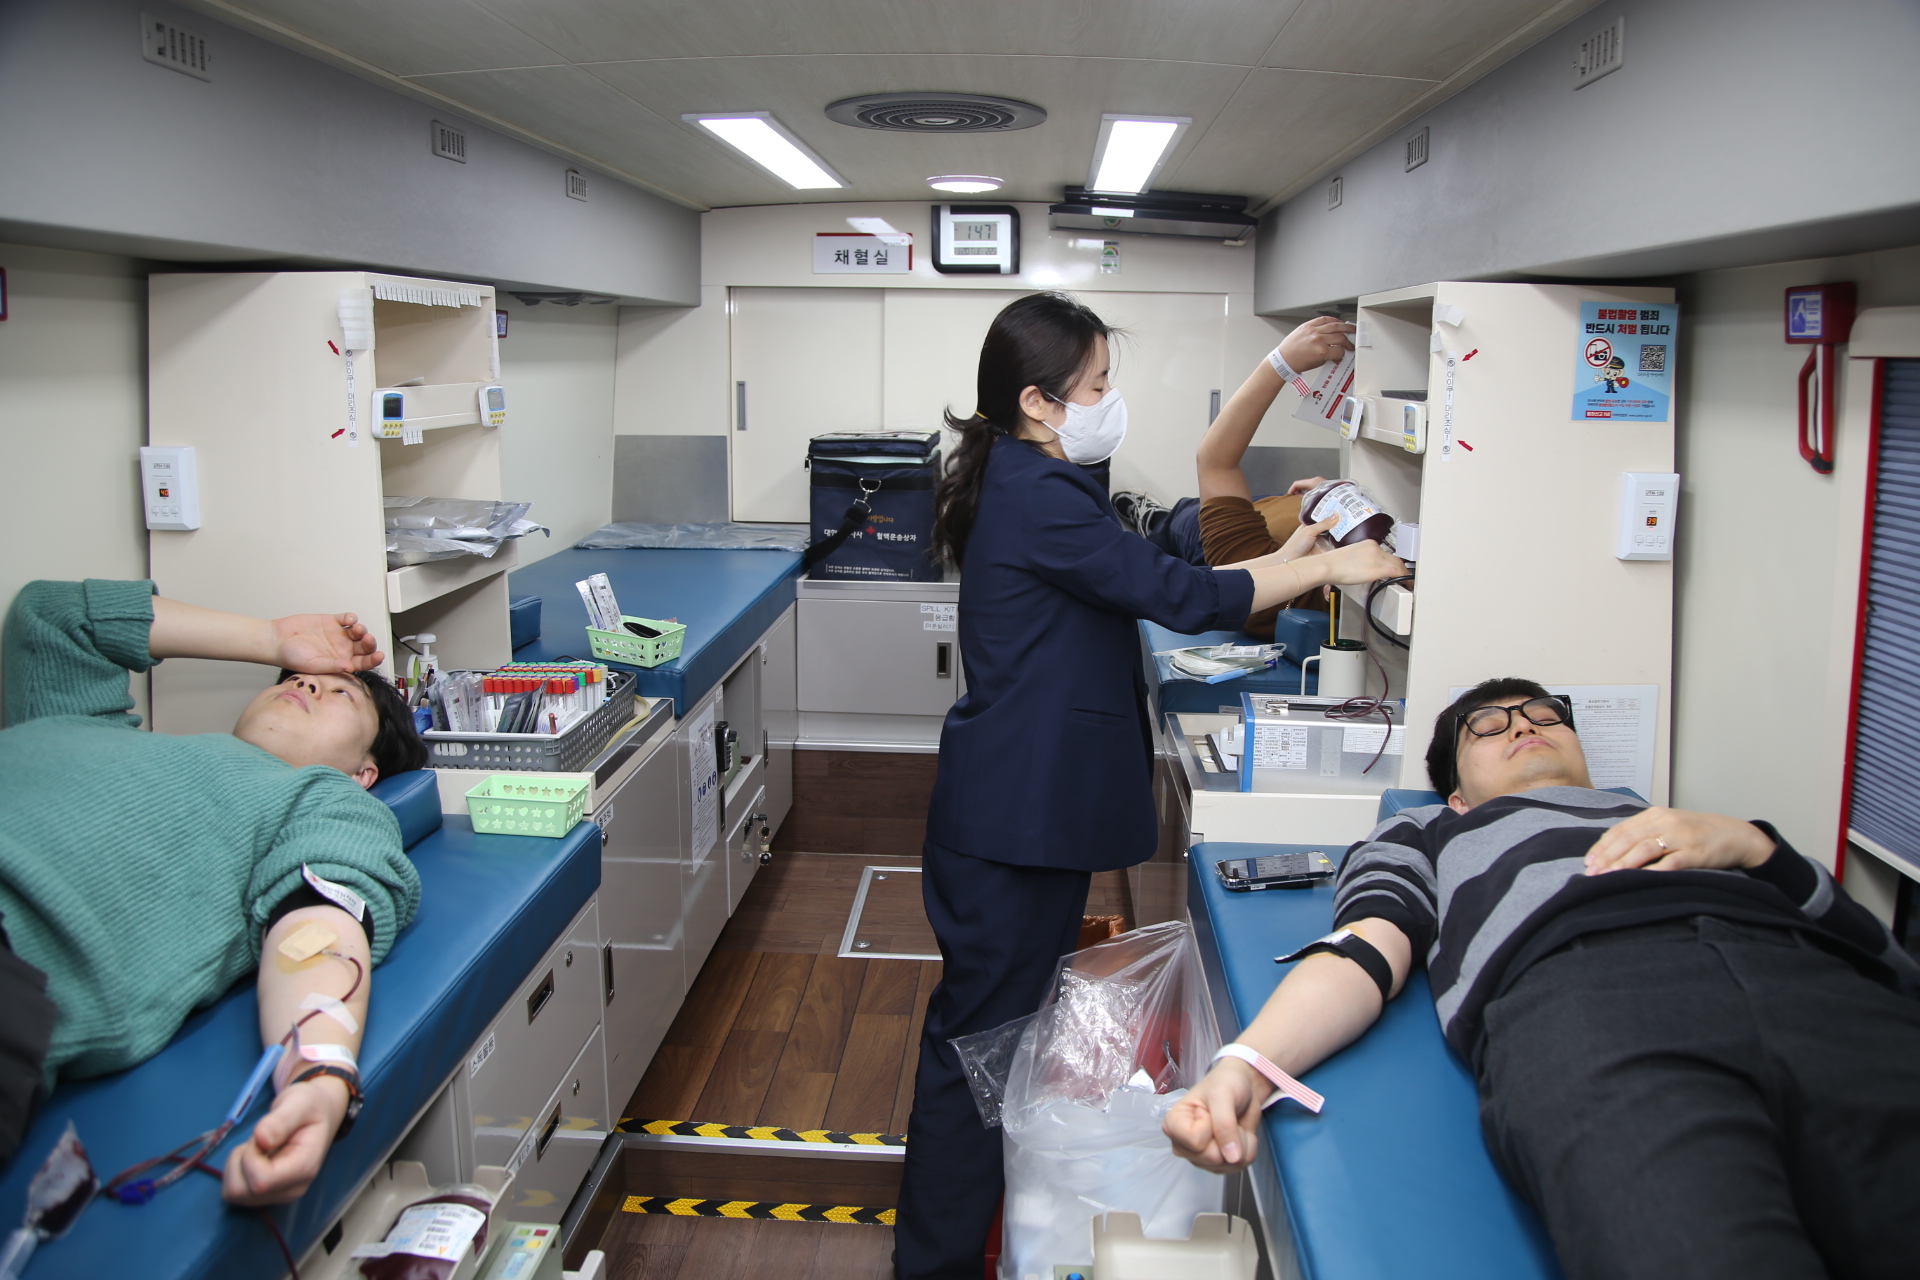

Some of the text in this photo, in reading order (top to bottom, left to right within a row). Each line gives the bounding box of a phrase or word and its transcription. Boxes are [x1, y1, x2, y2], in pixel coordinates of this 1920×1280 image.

[834, 249, 888, 265] 채혈실
[1598, 309, 1659, 321] 불법촬영 범죄
[1586, 323, 1670, 335] 반드시 처벌 됩니다
[1647, 517, 1657, 525] 39
[921, 605, 941, 613] SPILL
